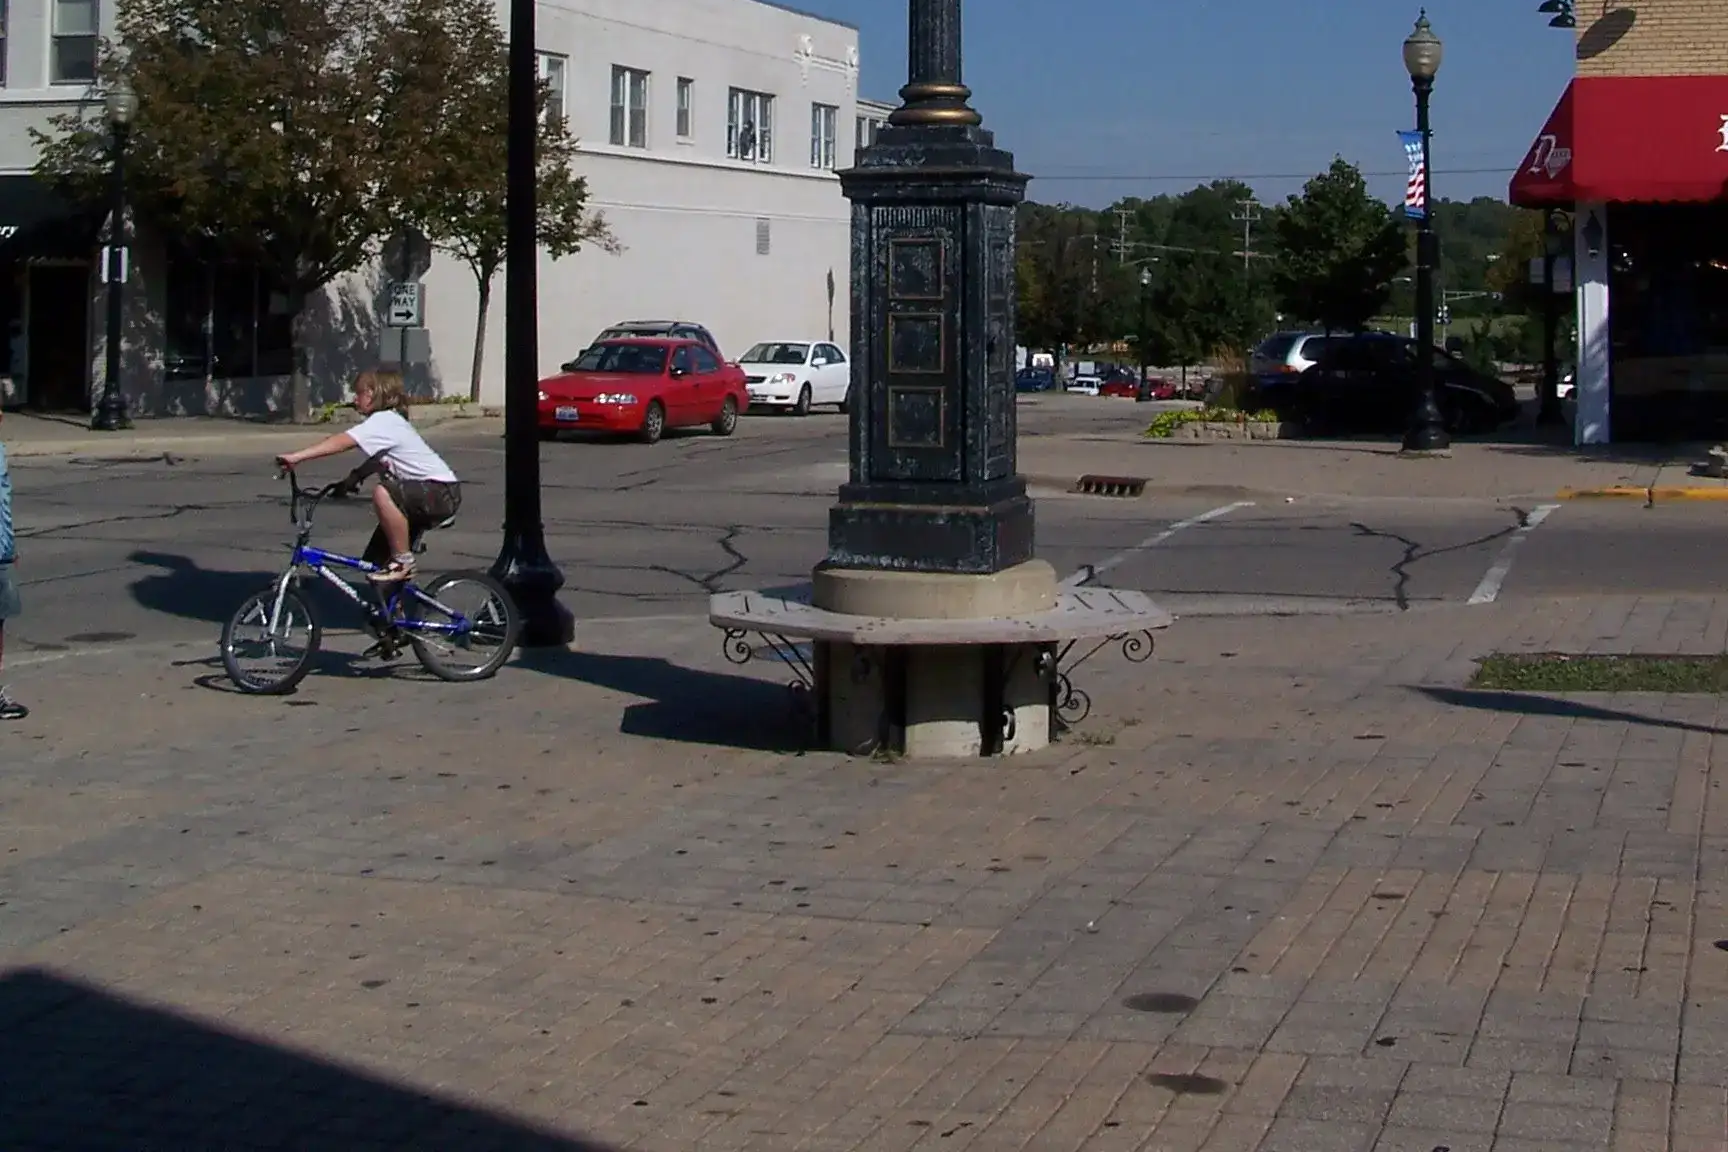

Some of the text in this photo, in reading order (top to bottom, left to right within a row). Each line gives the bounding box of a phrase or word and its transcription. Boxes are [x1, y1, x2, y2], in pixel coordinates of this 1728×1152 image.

[0, 225, 20, 238] ry
[393, 284, 415, 295] ONE
[393, 296, 416, 306] WAY
